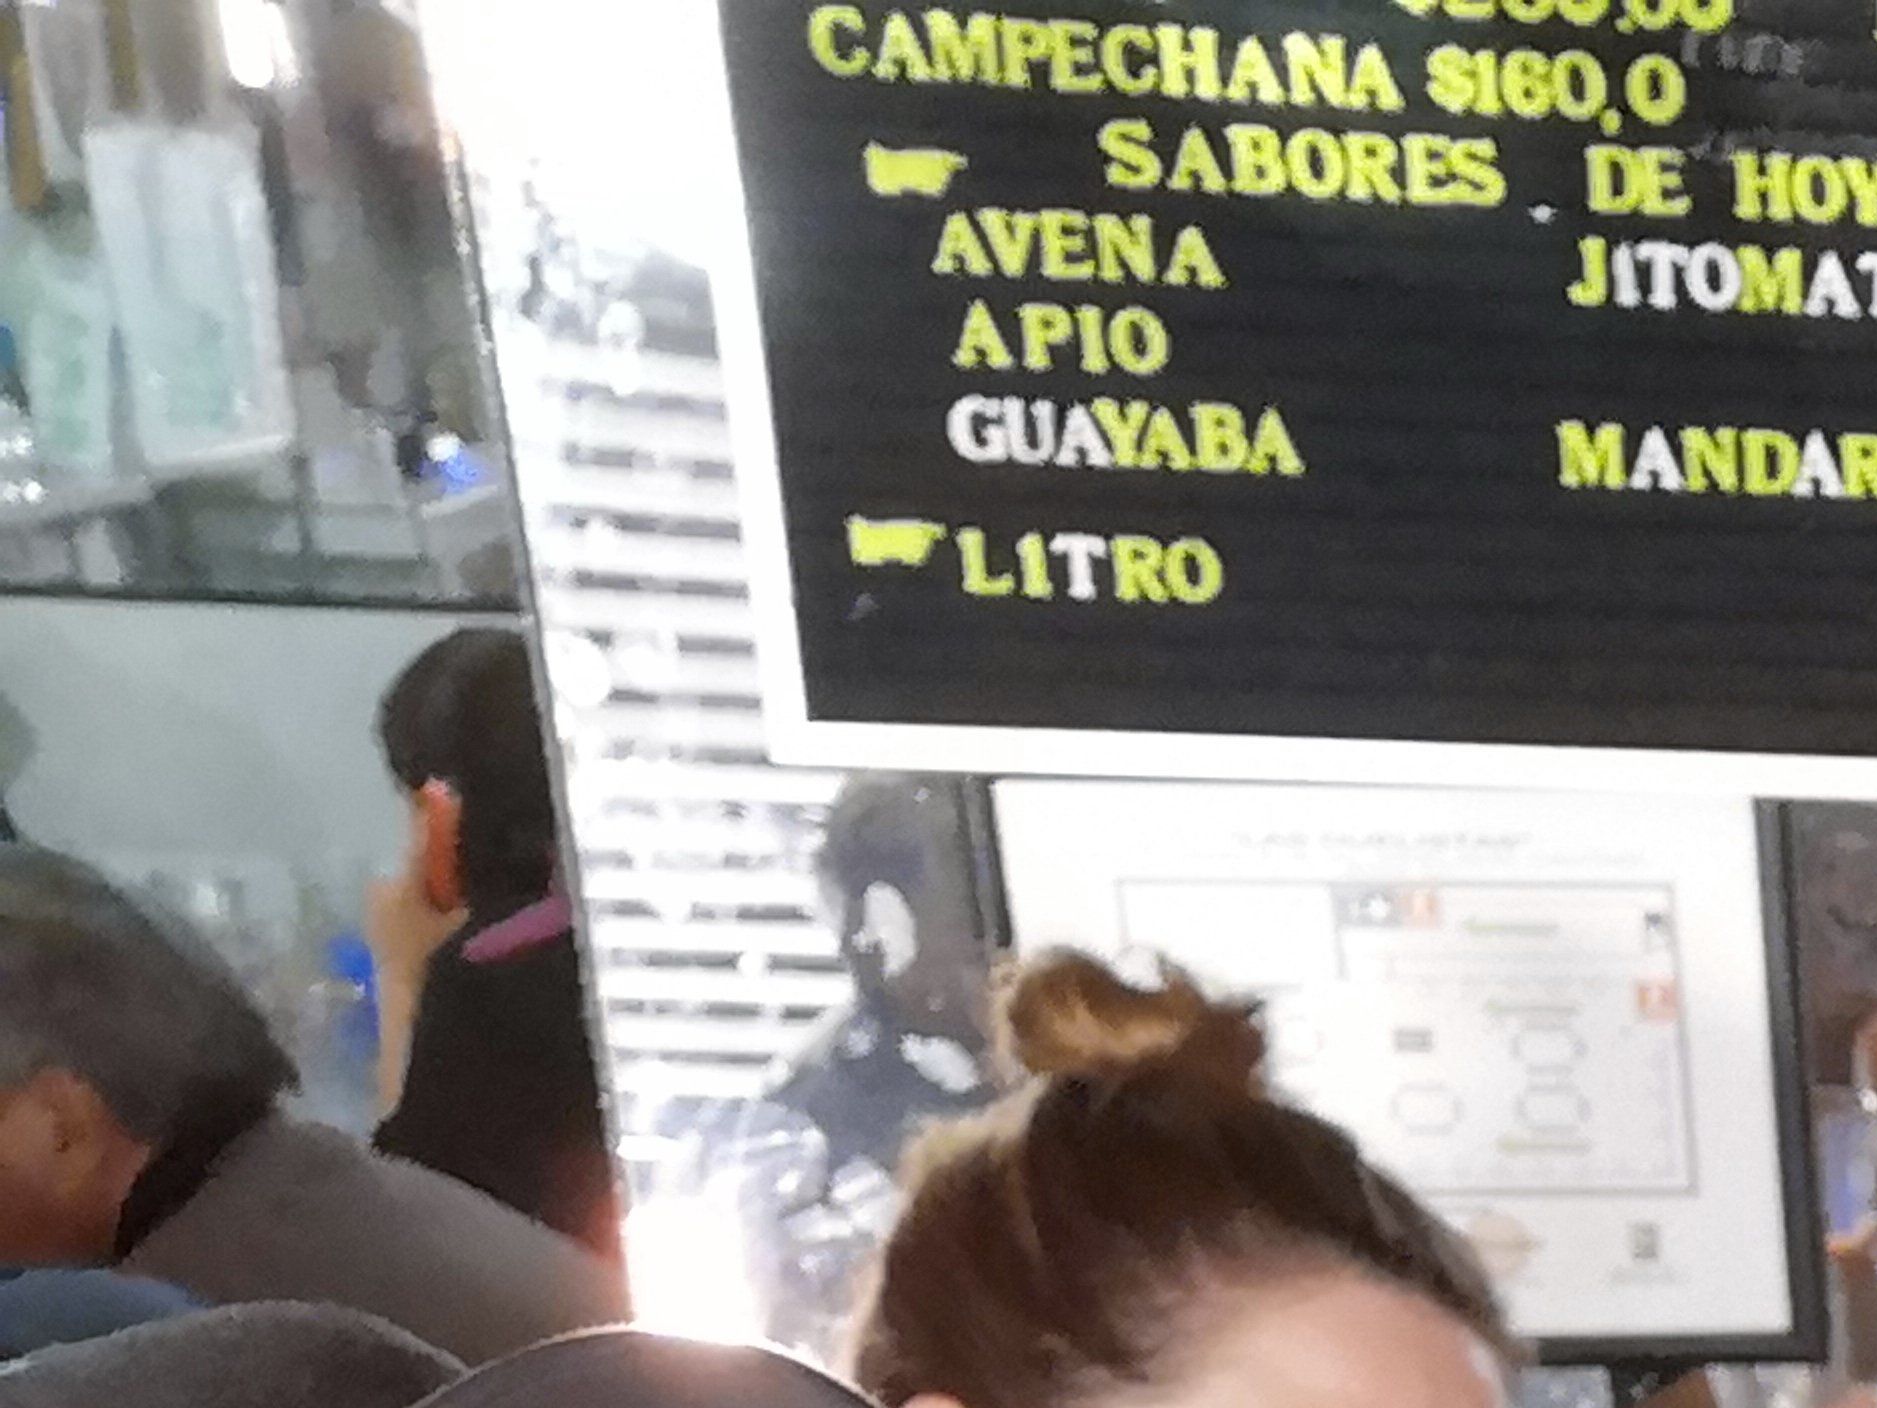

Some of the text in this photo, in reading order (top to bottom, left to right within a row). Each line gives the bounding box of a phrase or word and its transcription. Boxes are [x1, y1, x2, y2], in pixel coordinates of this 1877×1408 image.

[807, 3, 1406, 112] CAMPECHANA
[1425, 43, 1687, 137] $160.0
[1097, 116, 1508, 206] SABORES
[1584, 143, 1694, 217] DE
[930, 207, 1229, 289] AVENA
[951, 299, 1171, 375] APIO
[946, 393, 1306, 477] GUAYABA
[955, 526, 1224, 603] LITRO
